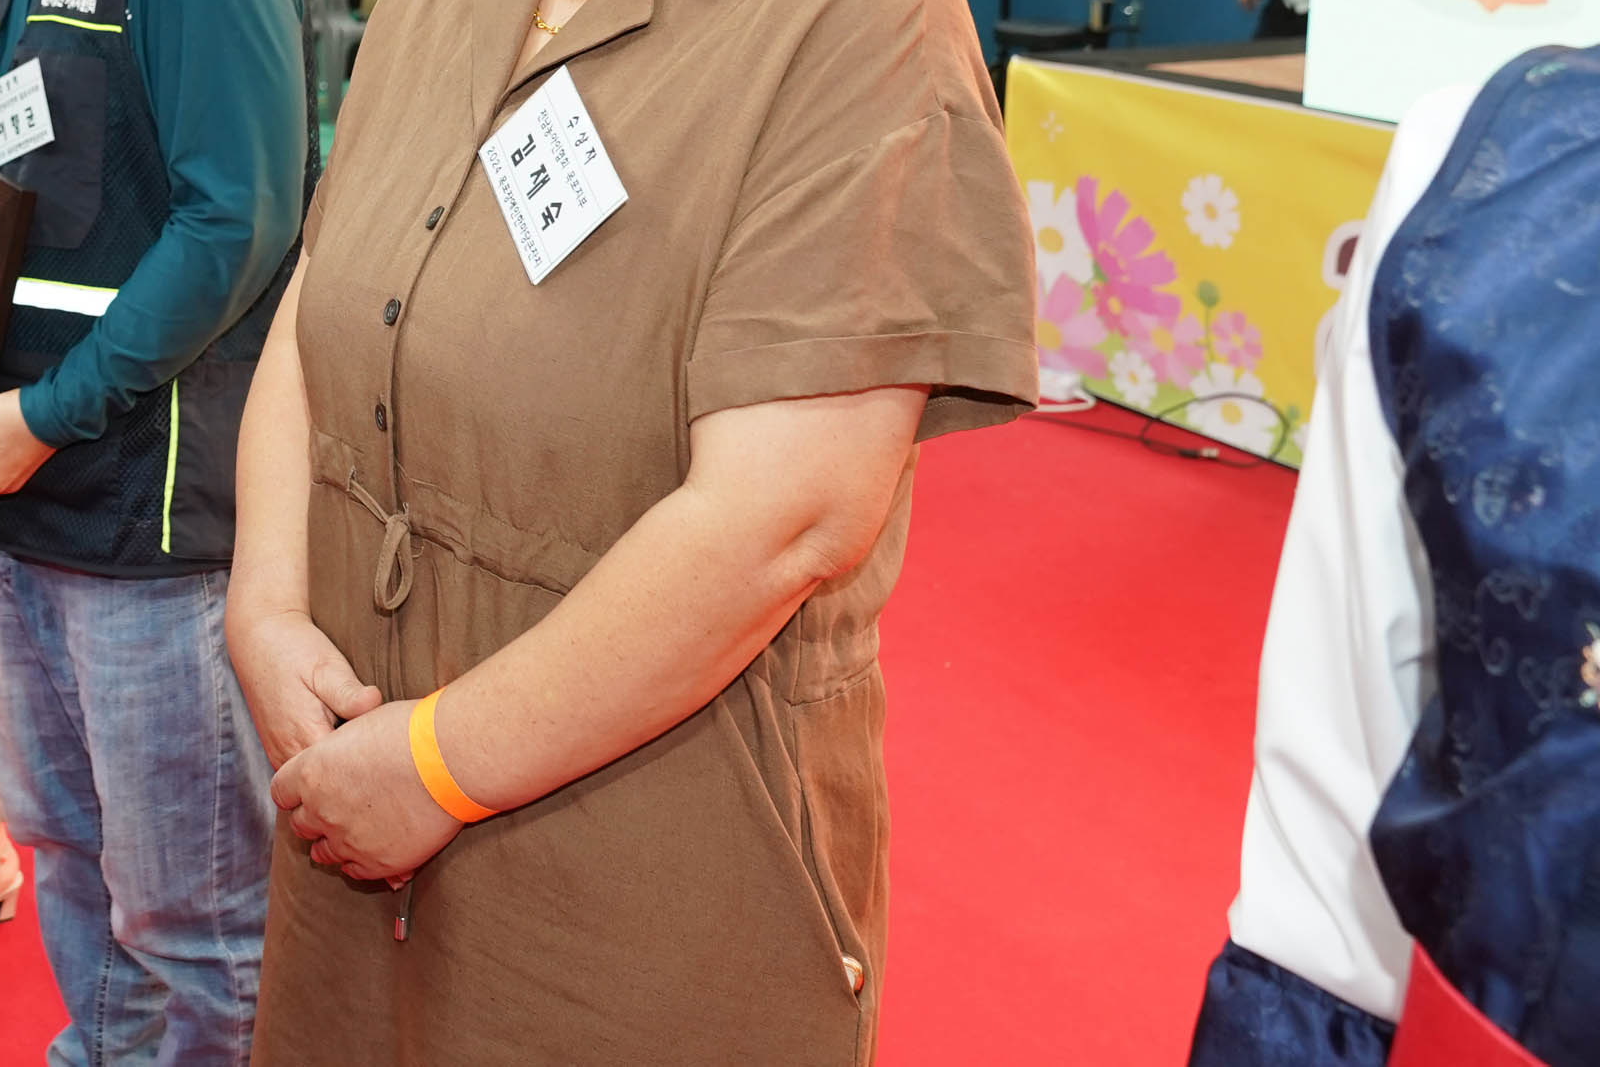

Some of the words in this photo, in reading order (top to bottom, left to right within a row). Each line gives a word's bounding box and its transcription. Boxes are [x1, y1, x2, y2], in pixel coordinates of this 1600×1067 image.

[487, 146, 502, 174] 2024
[511, 133, 563, 231] 김재숙
[567, 170, 588, 207] 목포지부
